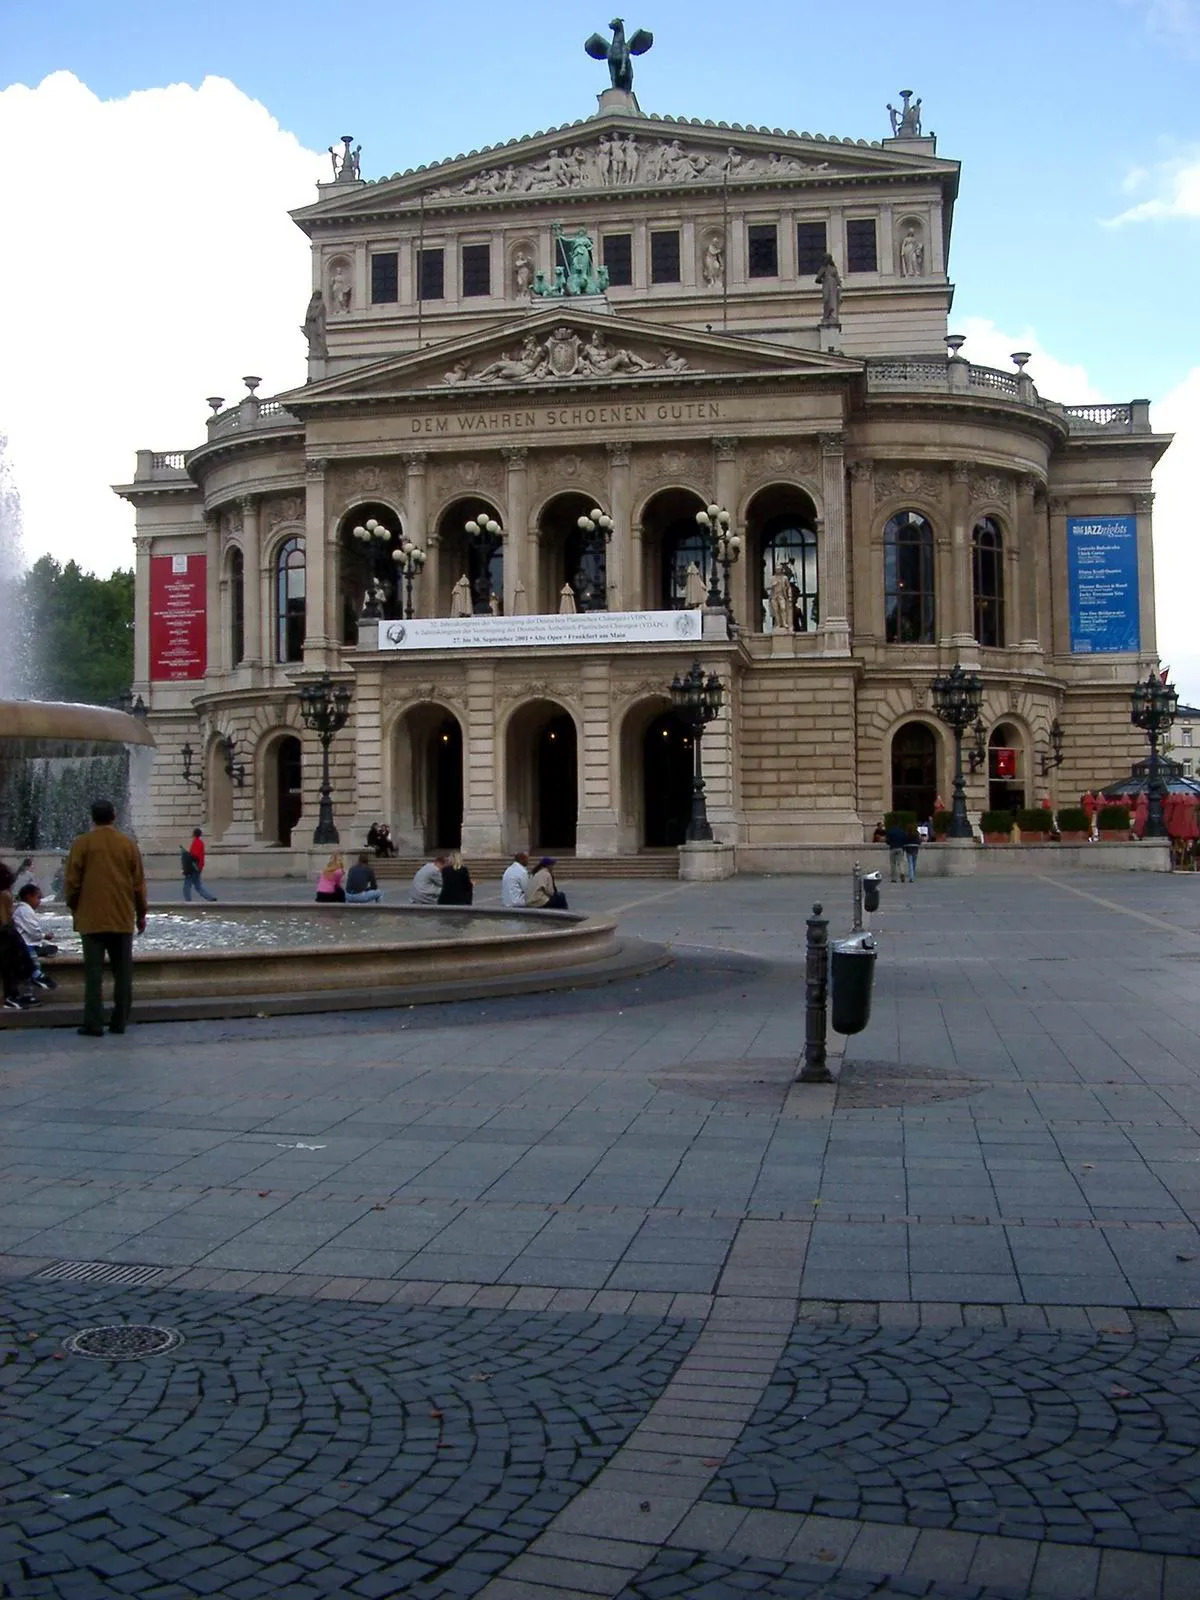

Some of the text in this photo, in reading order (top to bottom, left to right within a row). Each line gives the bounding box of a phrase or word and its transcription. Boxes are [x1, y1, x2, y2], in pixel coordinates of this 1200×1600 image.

[411, 417, 449, 433] DEM
[457, 411, 536, 430] WAHREN
[547, 406, 647, 425] SCHOENEN
